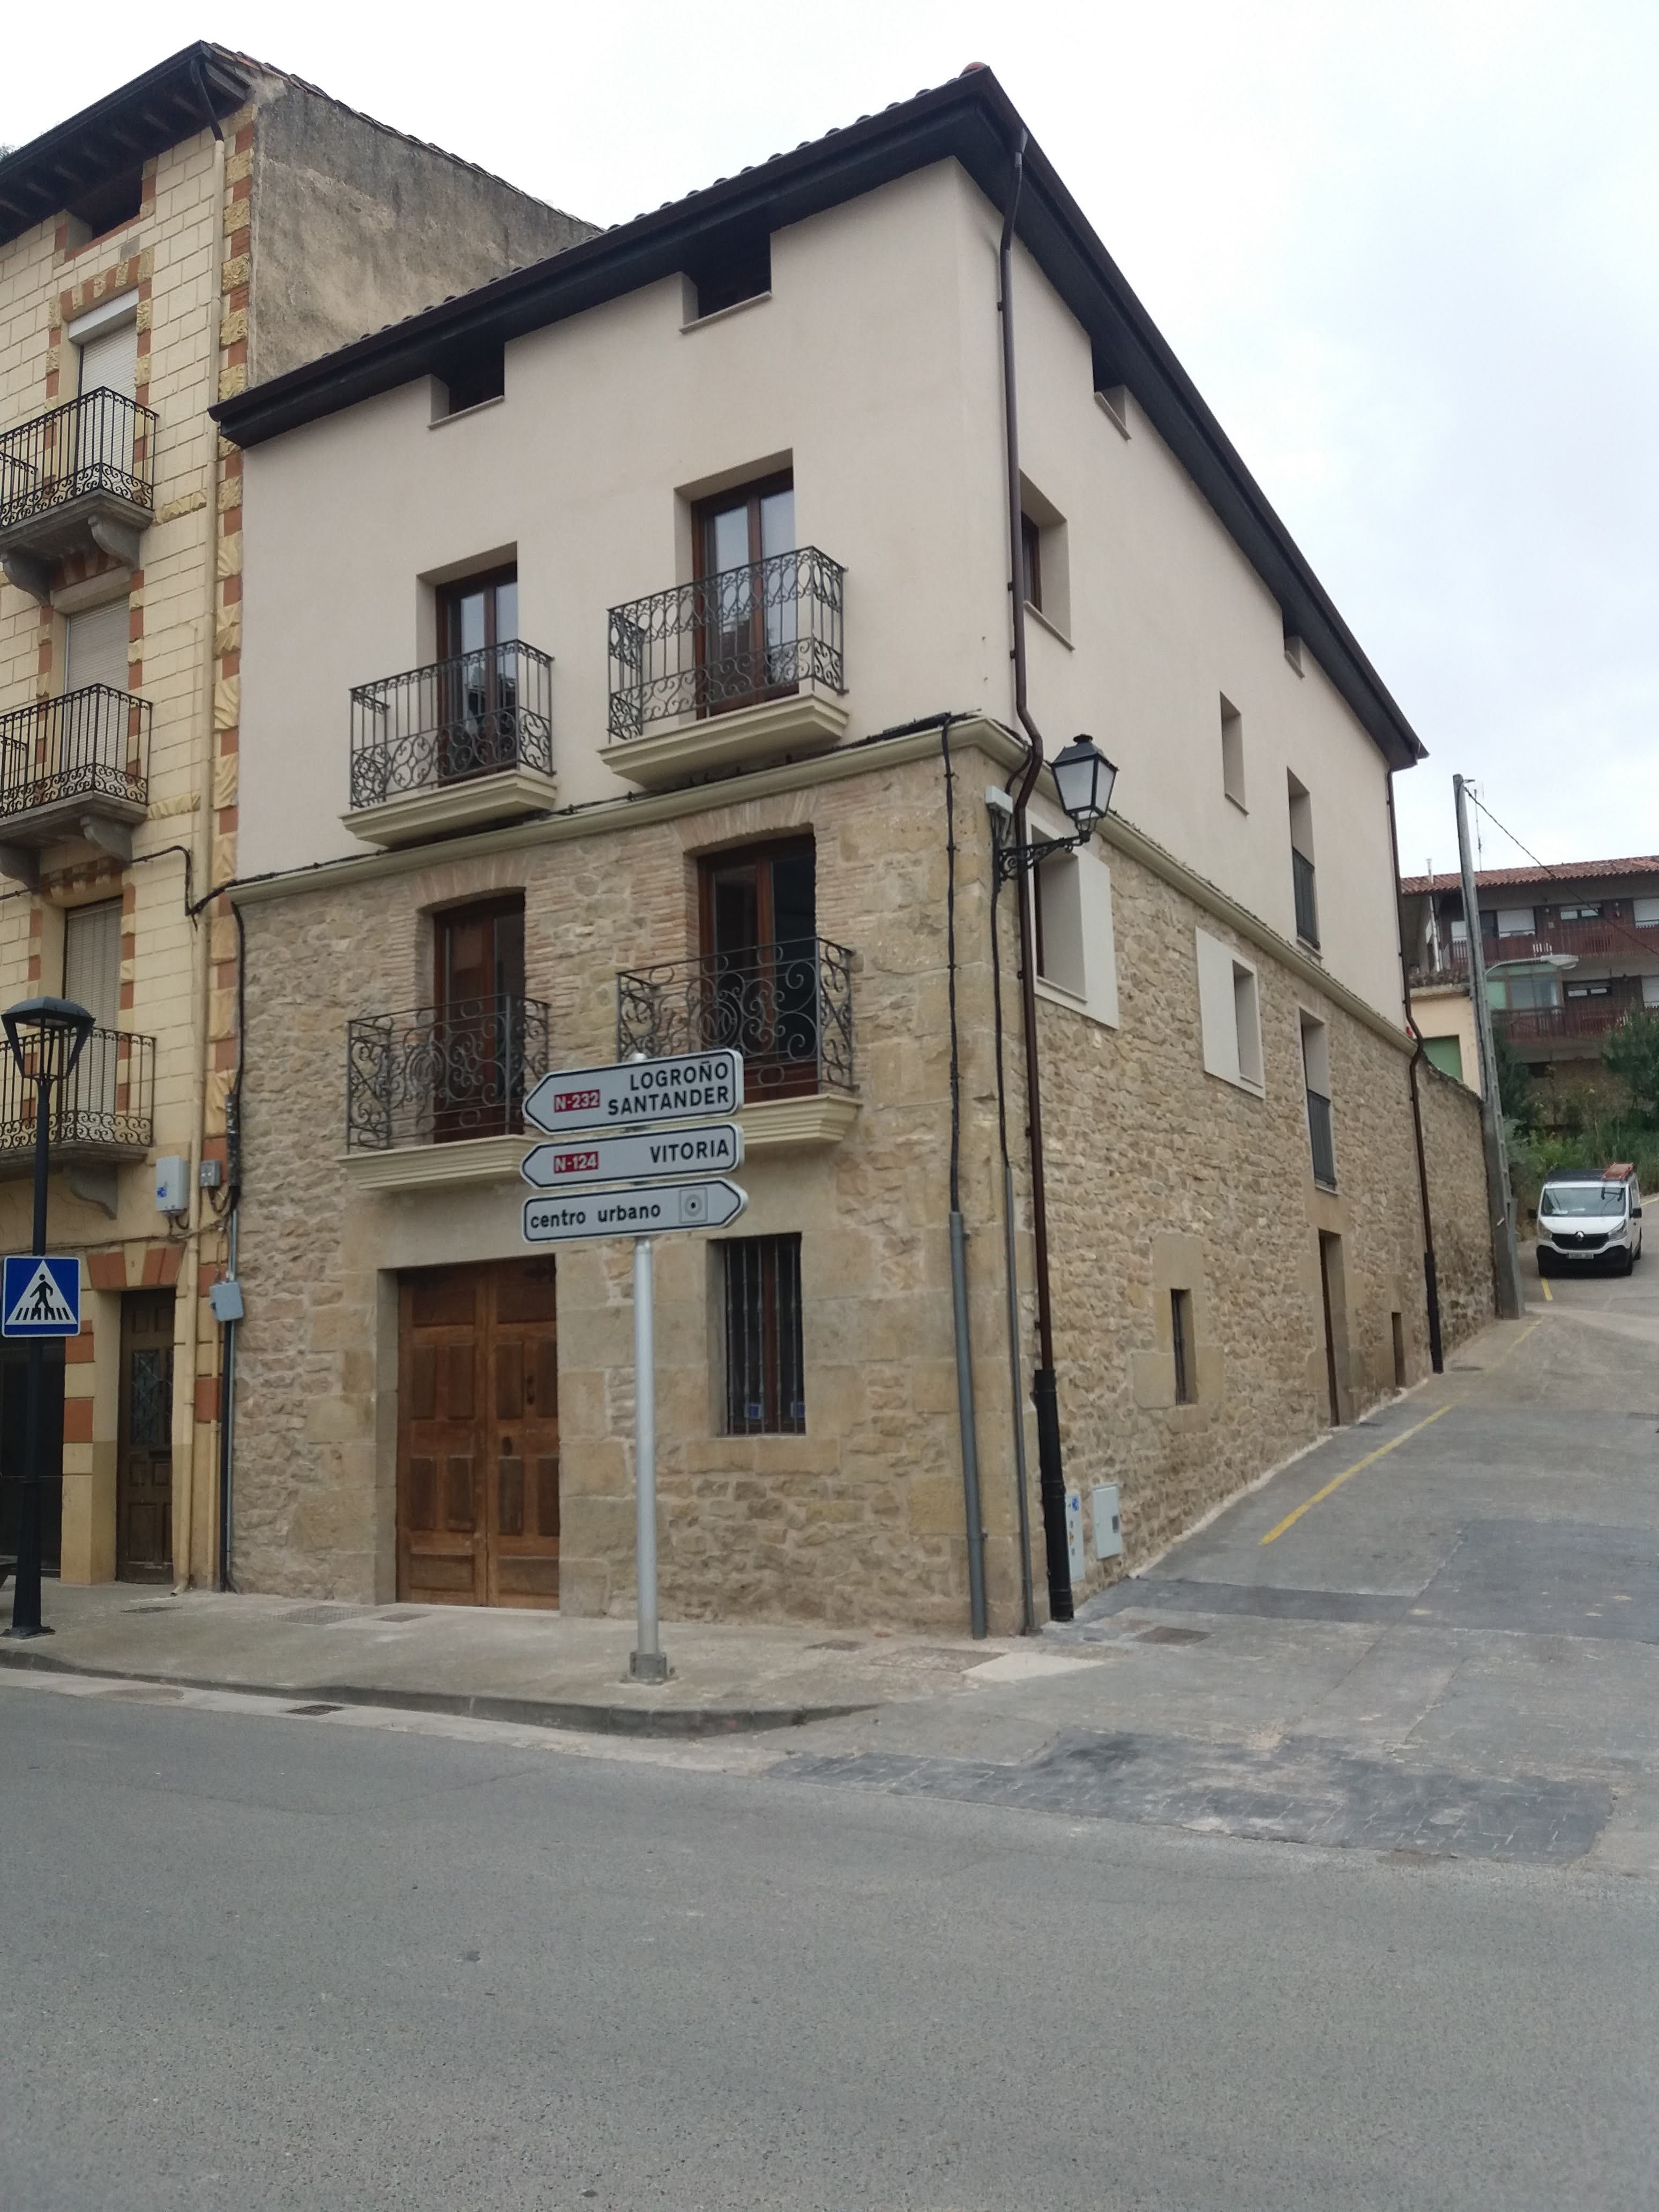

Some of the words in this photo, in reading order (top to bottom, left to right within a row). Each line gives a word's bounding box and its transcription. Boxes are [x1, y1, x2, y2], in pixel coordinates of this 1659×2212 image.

[630, 1061, 729, 1091] LOGROÑO
[555, 1093, 599, 1111] N-232
[608, 1086, 729, 1116] SANTANDER
[555, 1154, 597, 1172] N-124
[650, 1139, 729, 1163] VITORIA
[530, 1209, 586, 1228] centro
[598, 1204, 661, 1222] urbano
